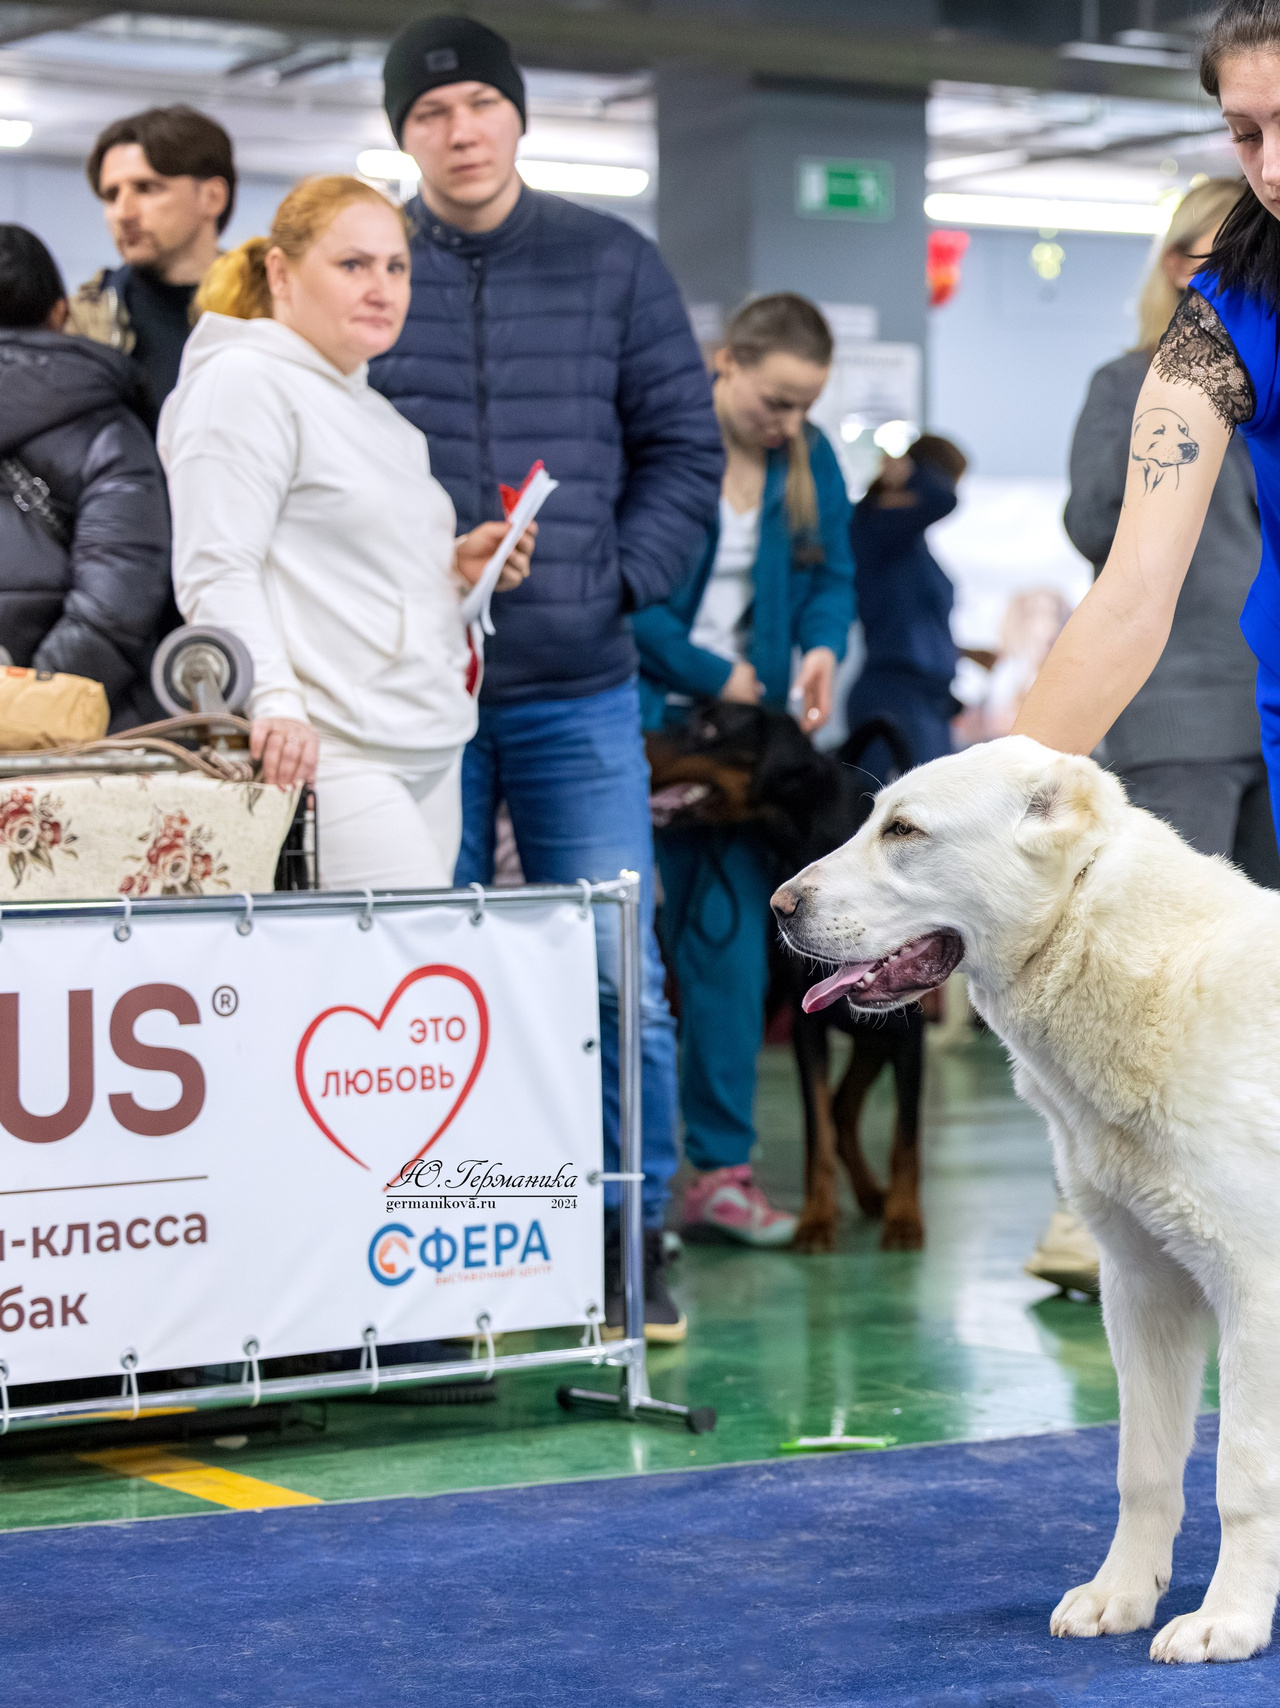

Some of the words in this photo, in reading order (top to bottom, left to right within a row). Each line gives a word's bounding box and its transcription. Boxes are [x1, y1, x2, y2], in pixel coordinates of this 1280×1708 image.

[409, 1016, 466, 1044] ЭТО
[321, 1064, 454, 1098] ЛЮБОВЬ
[0, 1212, 208, 1261] -класса
[368, 1219, 551, 1286] СФЕРА
